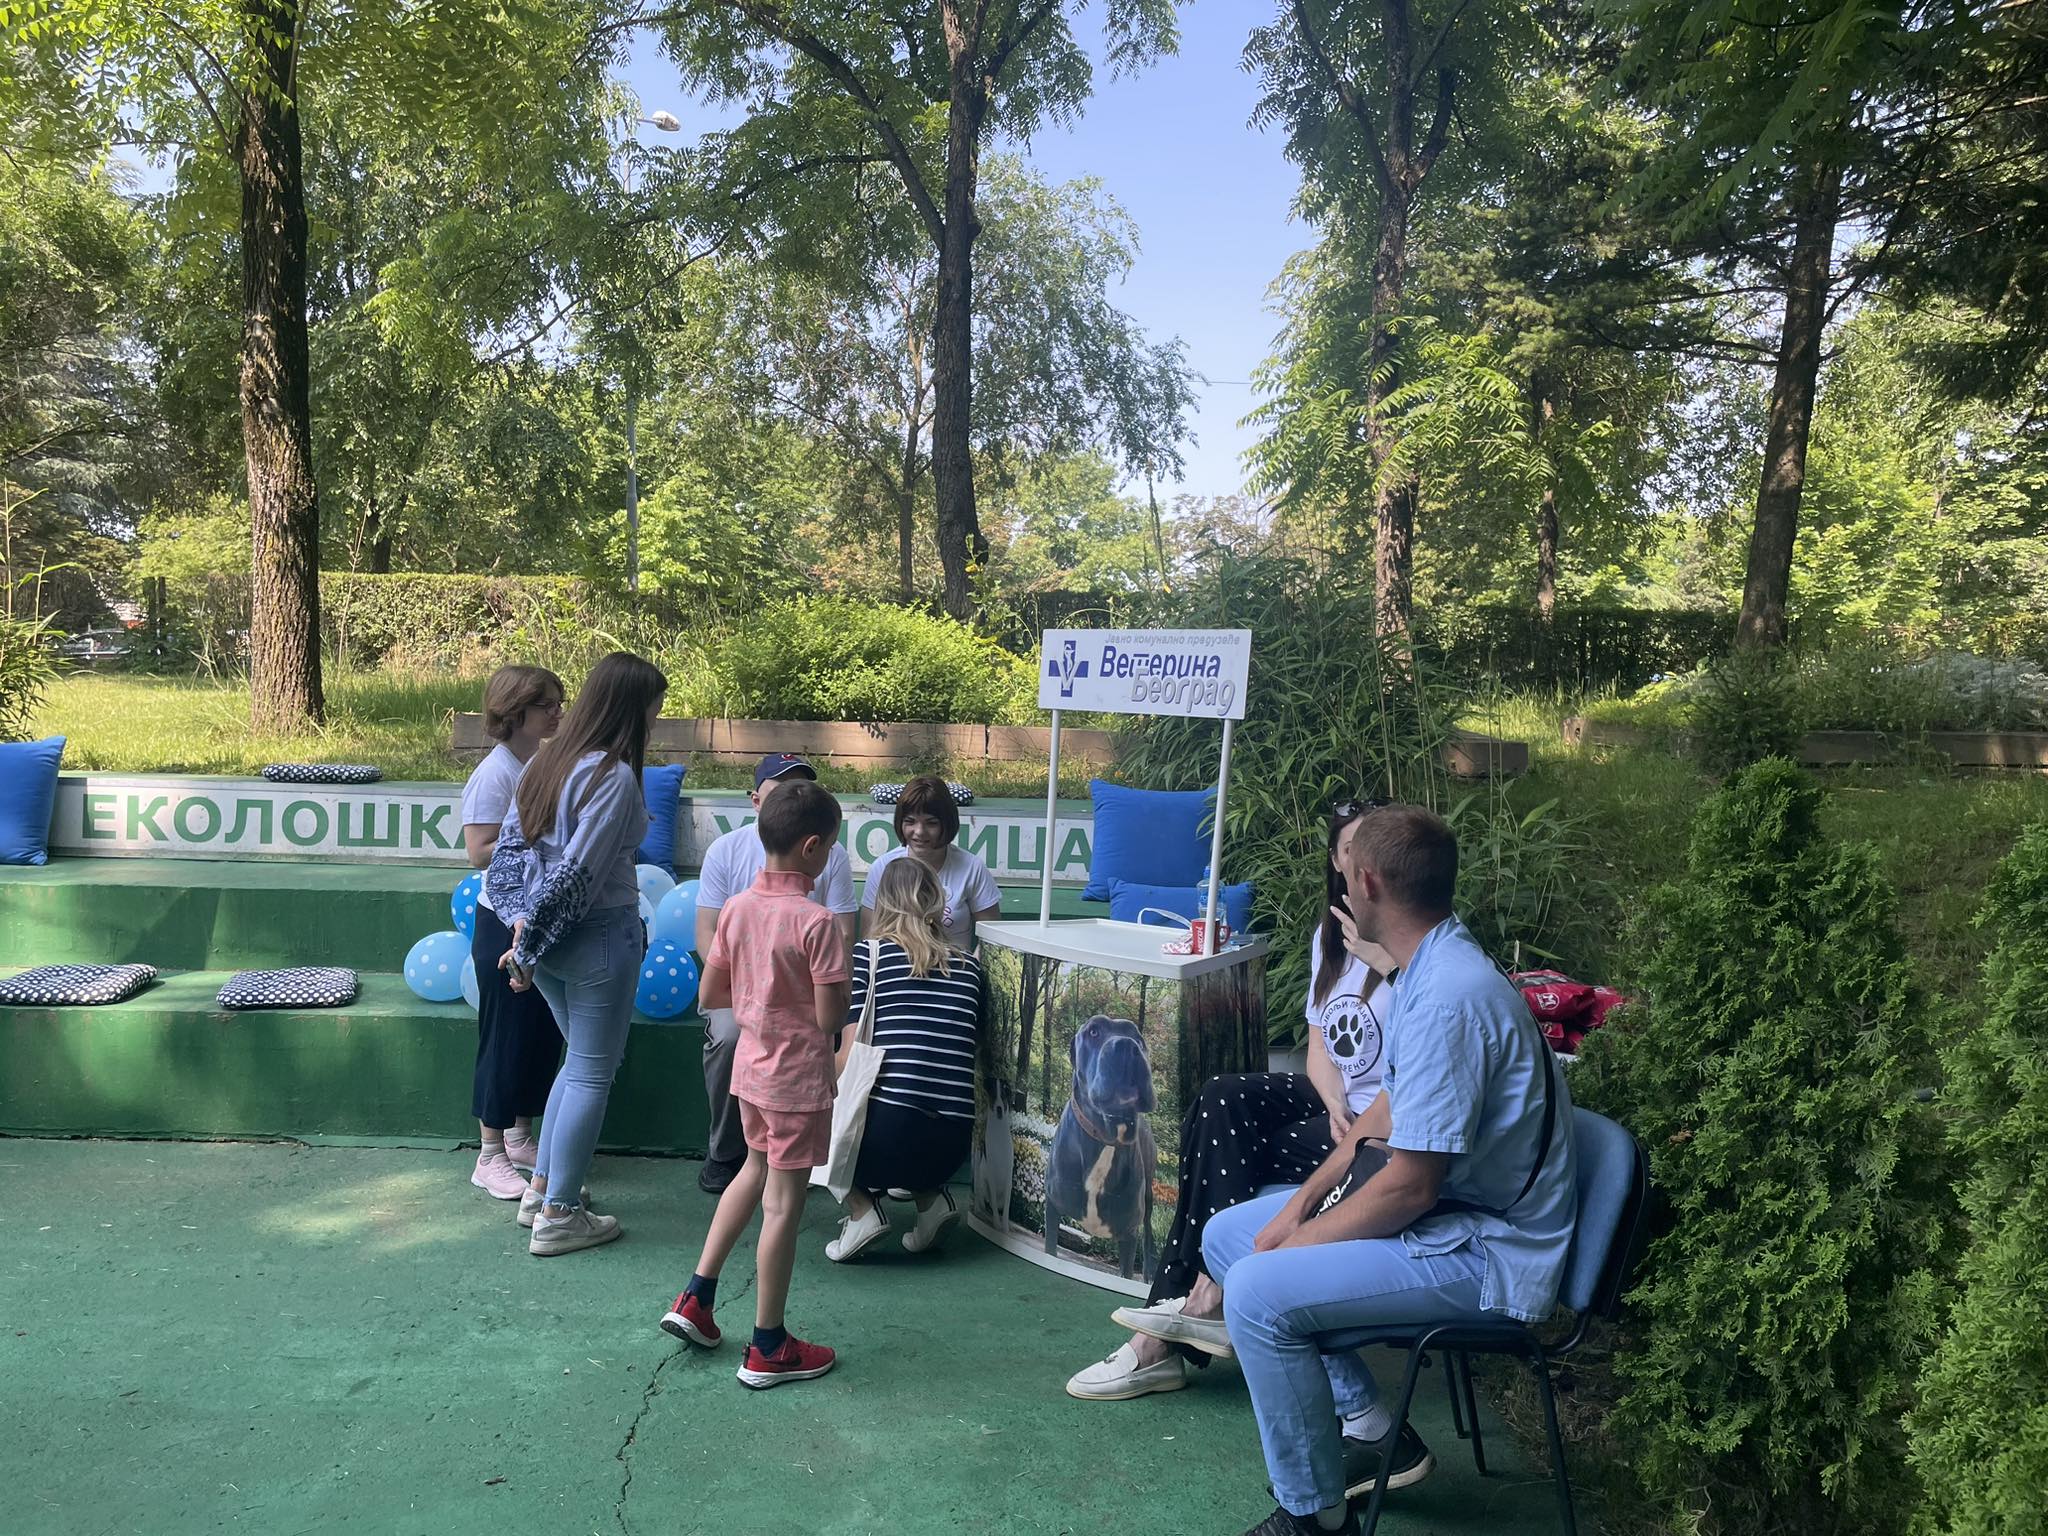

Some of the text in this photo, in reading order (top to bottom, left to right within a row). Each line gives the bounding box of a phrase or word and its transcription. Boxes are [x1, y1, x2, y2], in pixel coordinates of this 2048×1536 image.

[1134, 634, 1185, 646] комунално
[1099, 645, 1221, 680] Ветерина
[1131, 666, 1236, 716] Београд
[82, 793, 466, 850] ЕКОЛОШК
